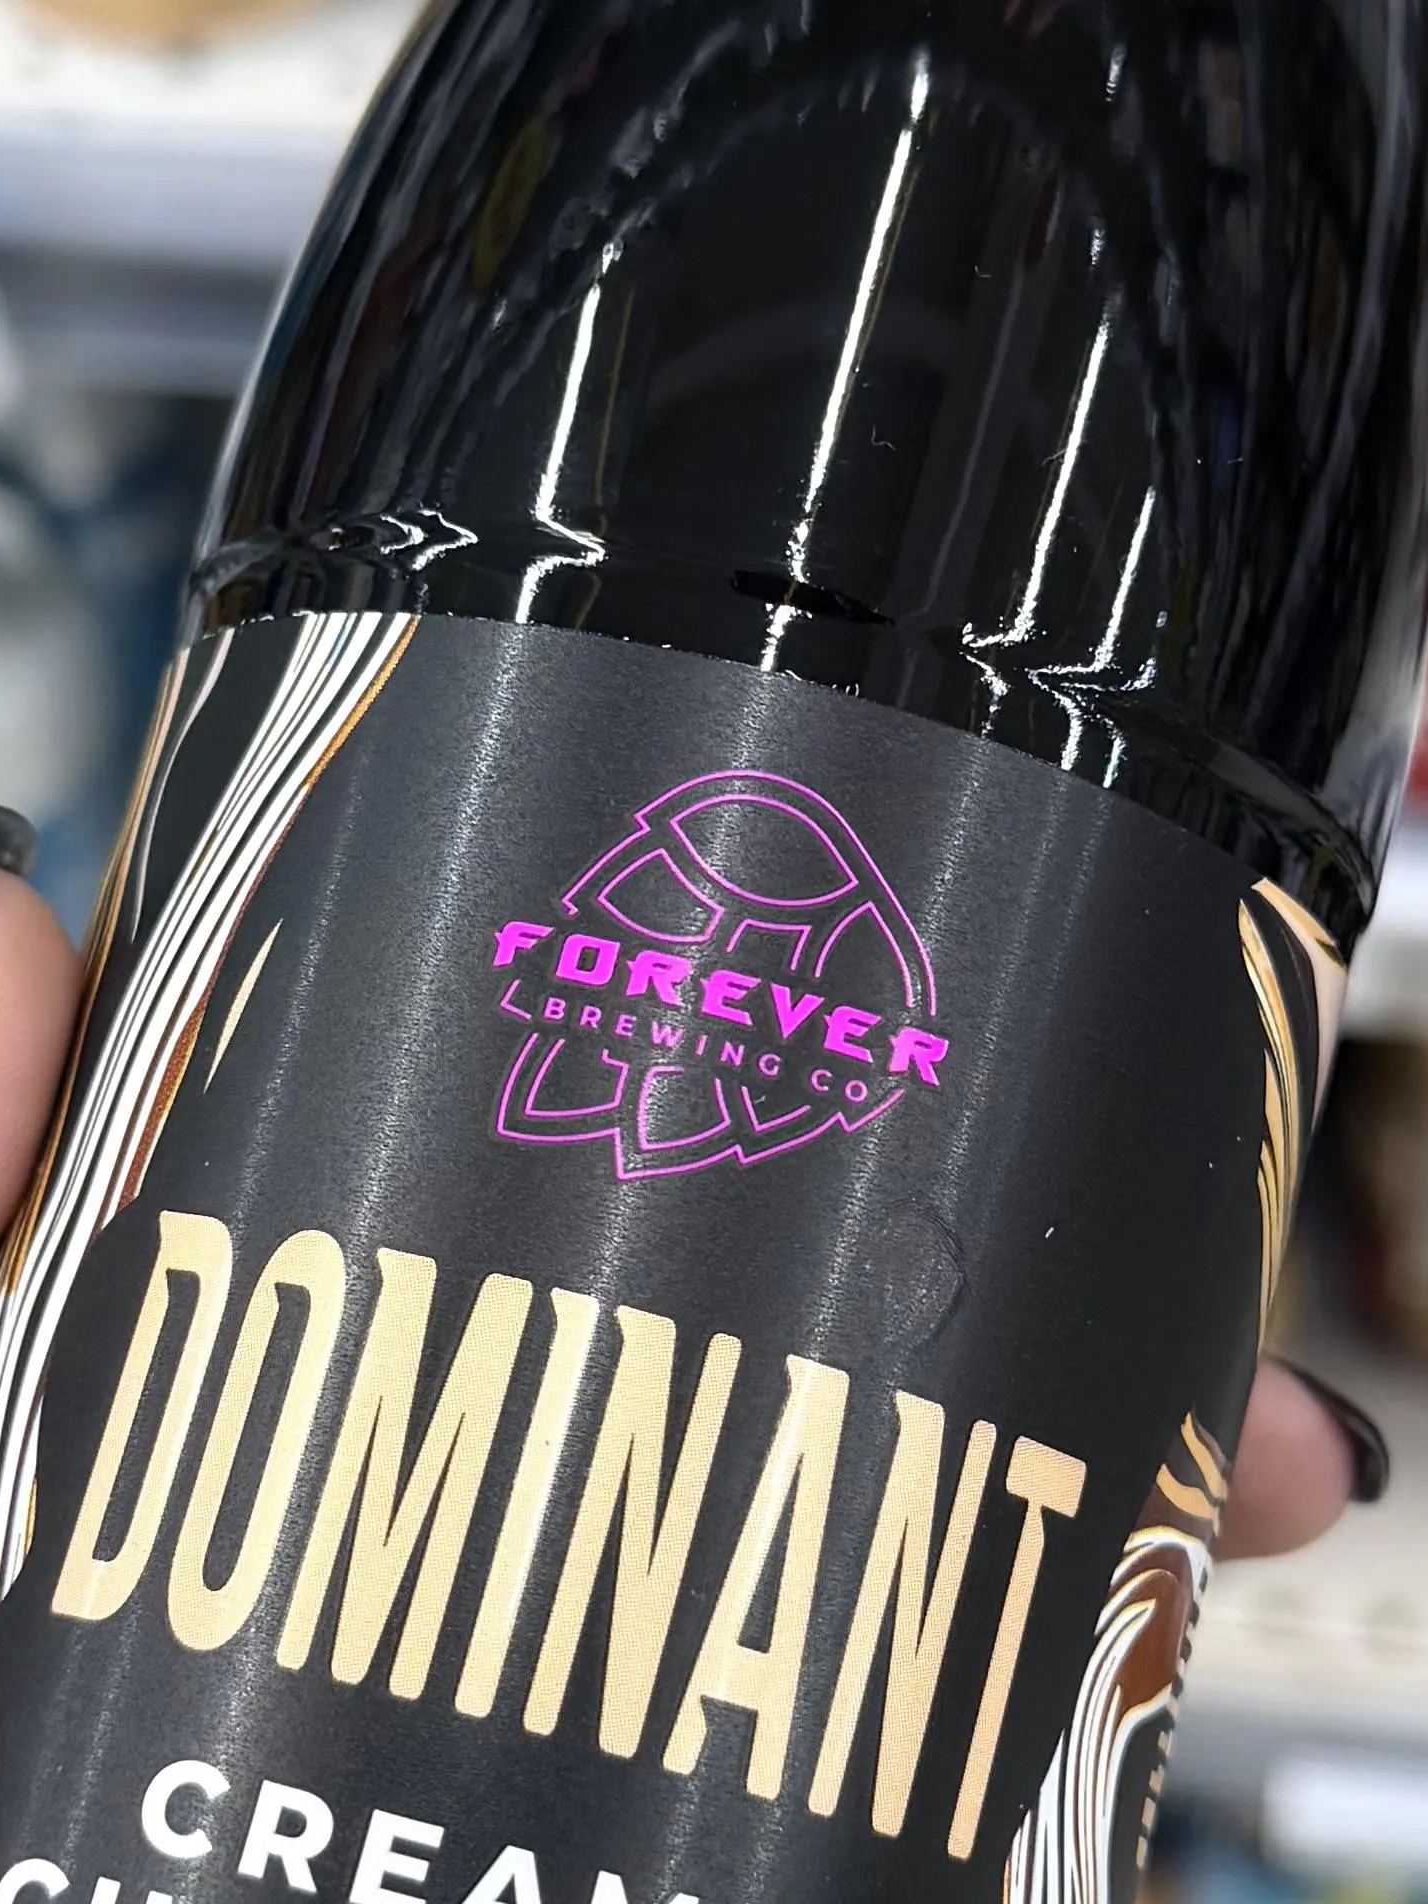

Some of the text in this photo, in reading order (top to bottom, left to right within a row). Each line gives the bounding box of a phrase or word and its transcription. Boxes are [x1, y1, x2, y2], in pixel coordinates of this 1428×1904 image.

[493, 921, 950, 1087] FOREVER
[543, 996, 869, 1104] BREWING CO
[50, 1209, 1089, 1861] DOMINANT
